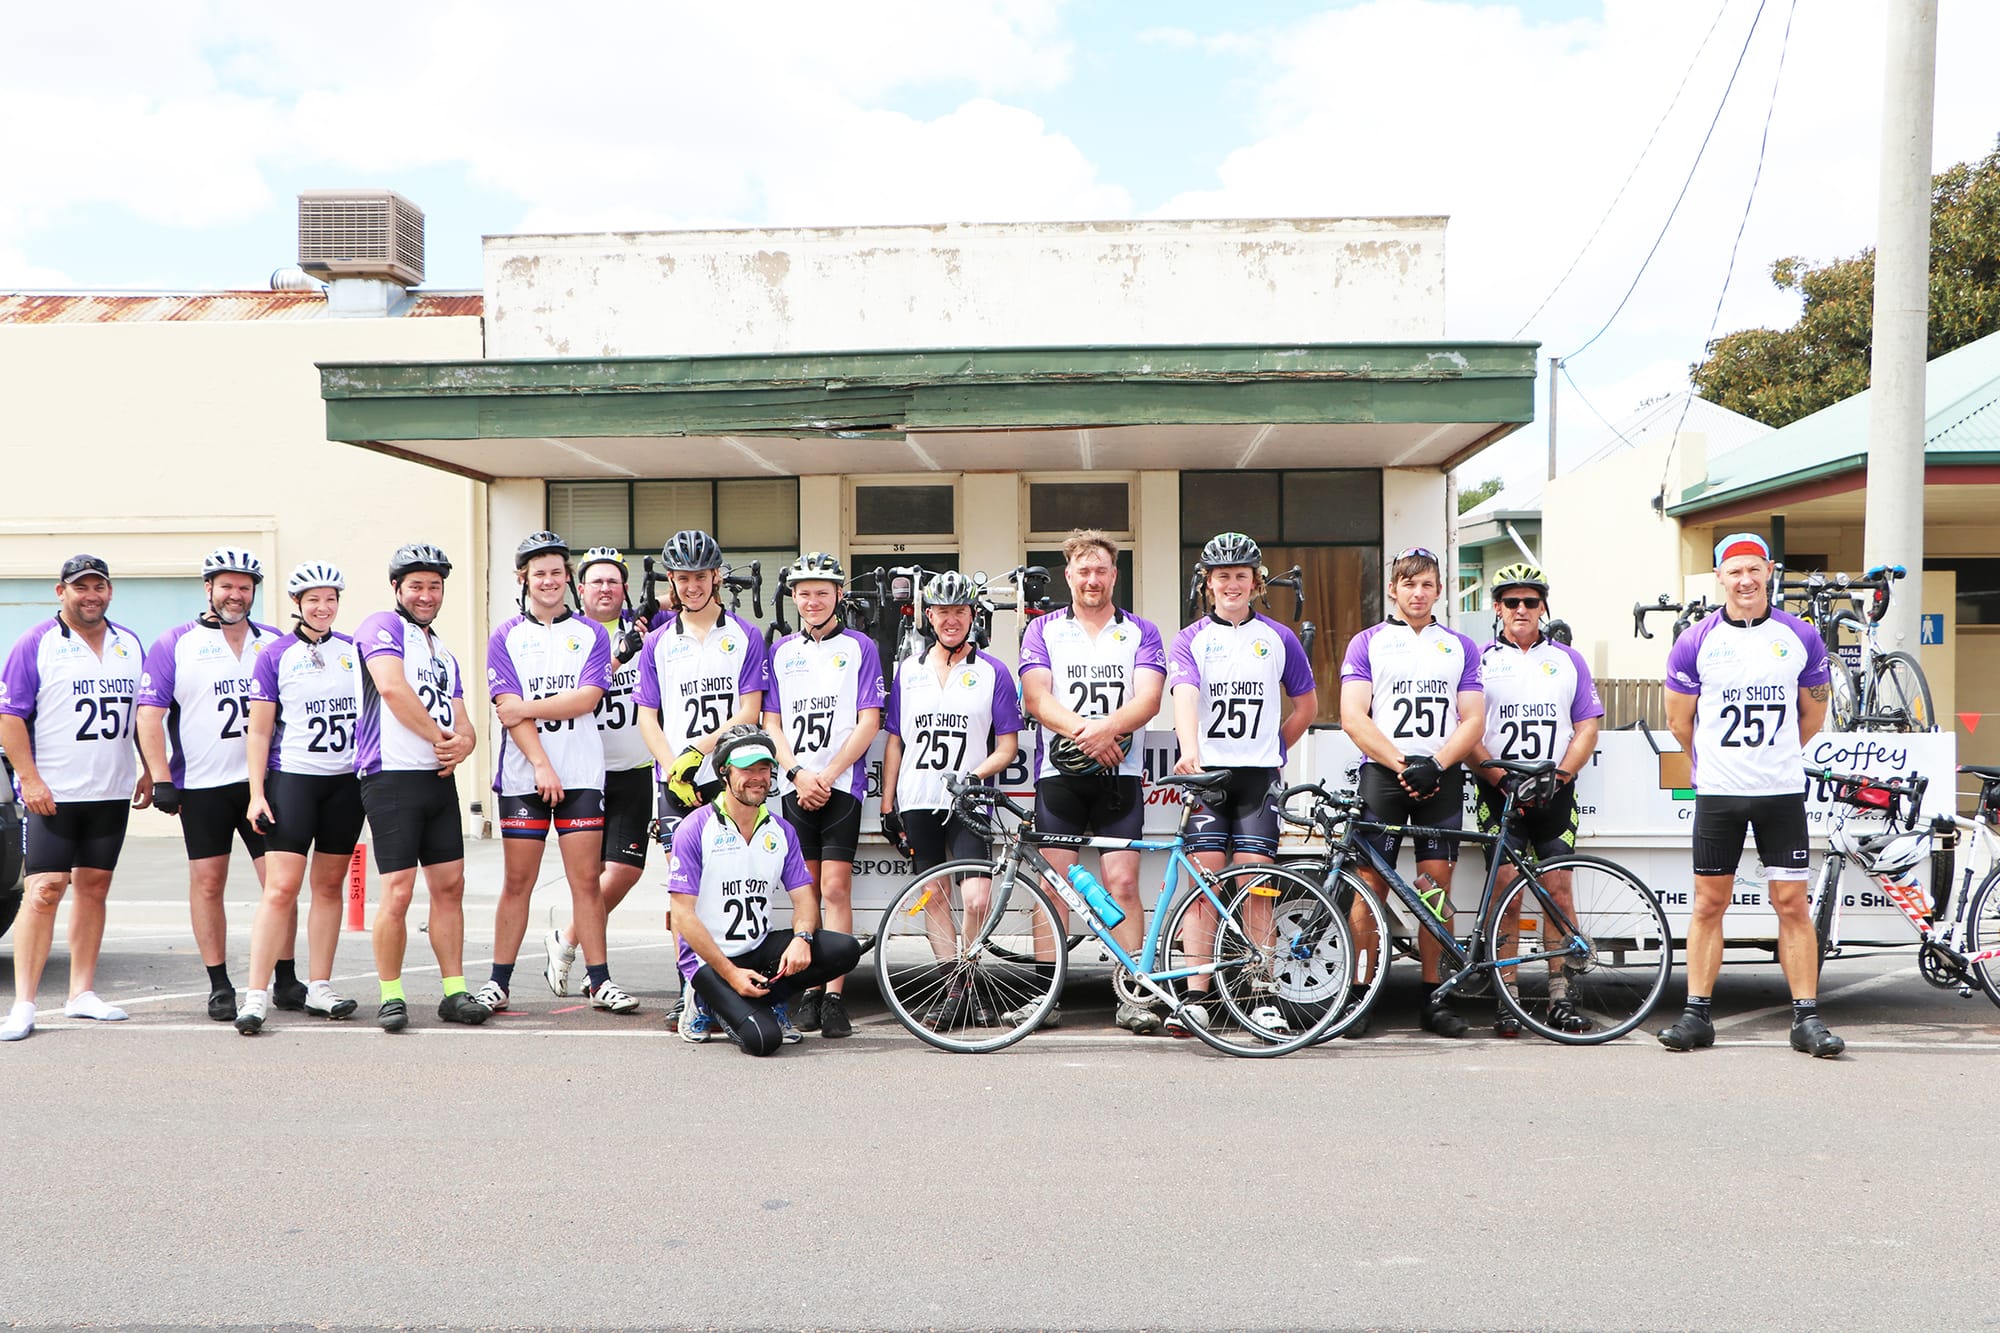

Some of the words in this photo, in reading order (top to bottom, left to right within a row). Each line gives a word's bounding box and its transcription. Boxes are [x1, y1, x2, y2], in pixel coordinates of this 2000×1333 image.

[893, 543, 905, 551] 36
[610, 669, 637, 687] HOTS
[1067, 664, 1087, 679] HOT
[1090, 664, 1125, 679] SHOTS
[73, 680, 95, 696] HOT
[99, 679, 135, 694] SHOTS
[214, 680, 235, 696] HOT
[546, 674, 576, 690] SHOTS
[680, 680, 698, 697] HOT
[701, 676, 733, 692] SHOTS
[1209, 682, 1229, 697] HOT
[1231, 681, 1265, 696] SHOTS
[1392, 680, 1413, 695] HOT
[1417, 679, 1448, 694] SHOTS
[1069, 681, 1125, 717] 257
[1746, 685, 1786, 701] SHOTS
[305, 699, 327, 715] HOT
[793, 698, 809, 714] HOT
[1500, 703, 1519, 719] HOT
[1522, 703, 1557, 717] SHOTS
[75, 696, 133, 741] 257
[685, 692, 734, 739] 257
[915, 713, 934, 729] HOT
[935, 712, 969, 729] SHOTS
[1207, 698, 1264, 739] 257
[1393, 696, 1450, 738] 257
[307, 712, 357, 753] 257
[792, 710, 834, 756] 257
[1720, 704, 1786, 747] 257
[1500, 719, 1557, 760] 257
[916, 729, 967, 771] 257
[1814, 742, 1907, 770] Coffey
[1042, 835, 1083, 843] DIABLO
[722, 879, 742, 896] HOT
[745, 878, 768, 894] SOTS
[1655, 889, 1687, 905] THE
[1729, 893, 1761, 906] LEE
